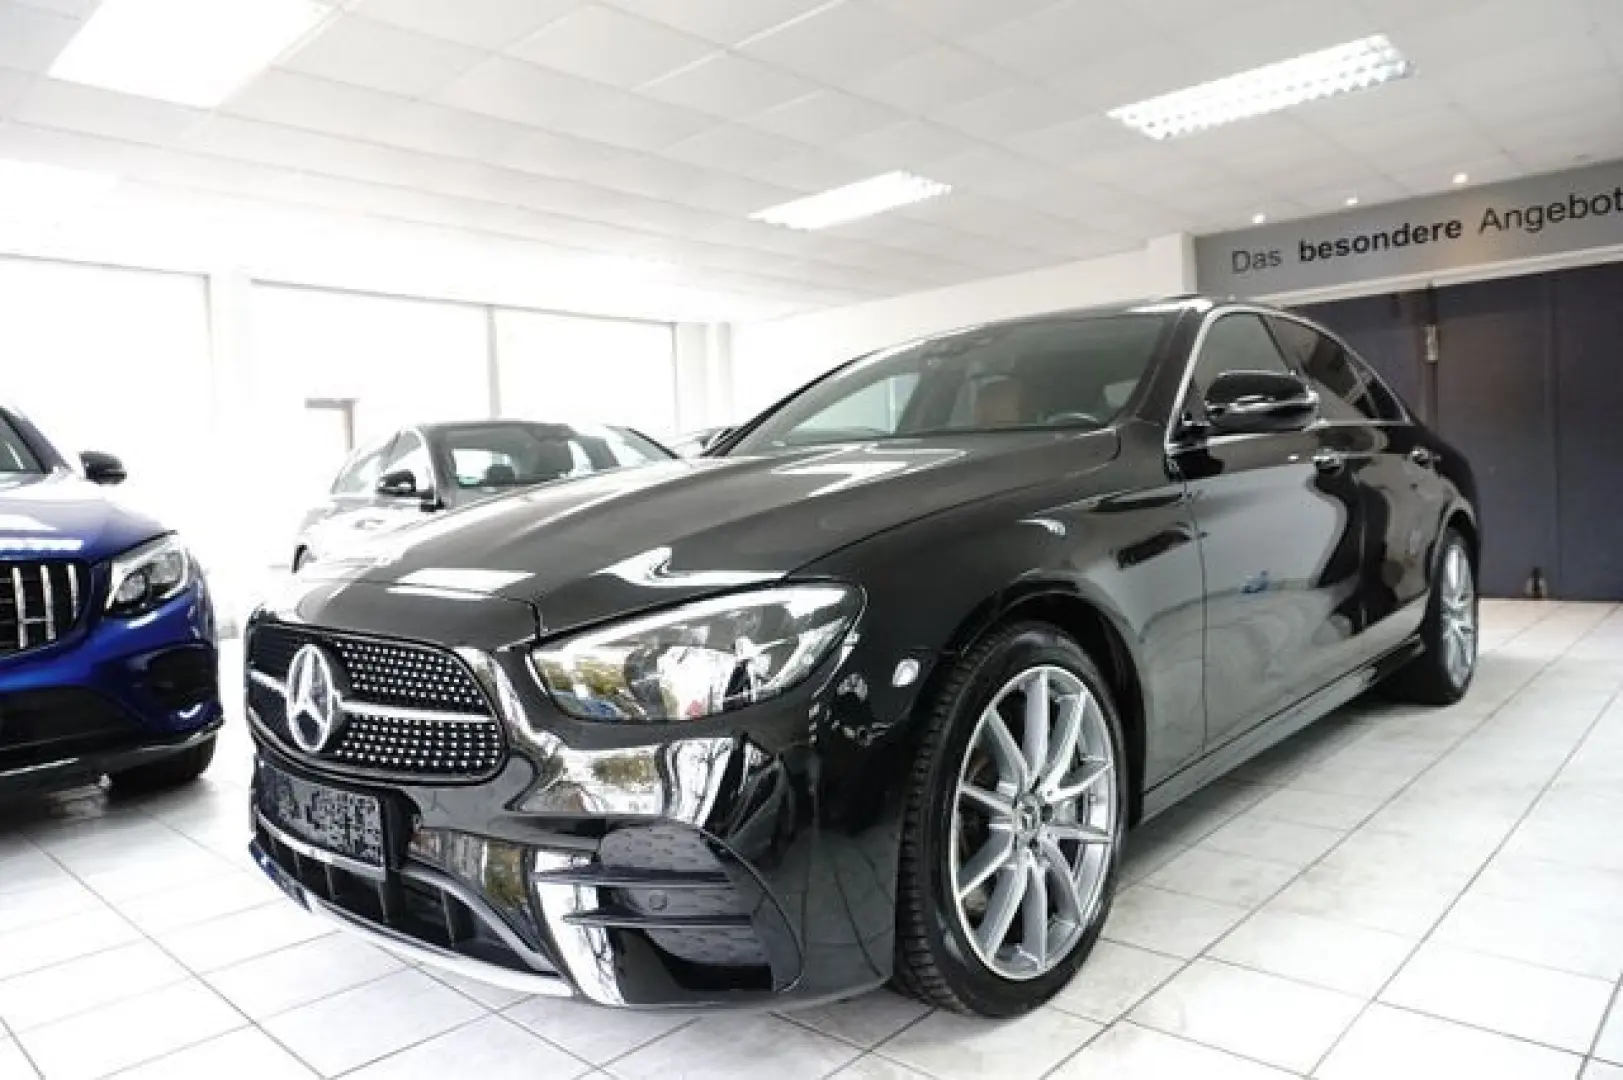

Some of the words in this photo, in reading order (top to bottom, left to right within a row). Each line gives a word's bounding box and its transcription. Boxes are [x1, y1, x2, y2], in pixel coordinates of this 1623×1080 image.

[1231, 249, 1282, 274] Das
[1300, 219, 1462, 262] besondere
[1479, 187, 1623, 234] Angebot
